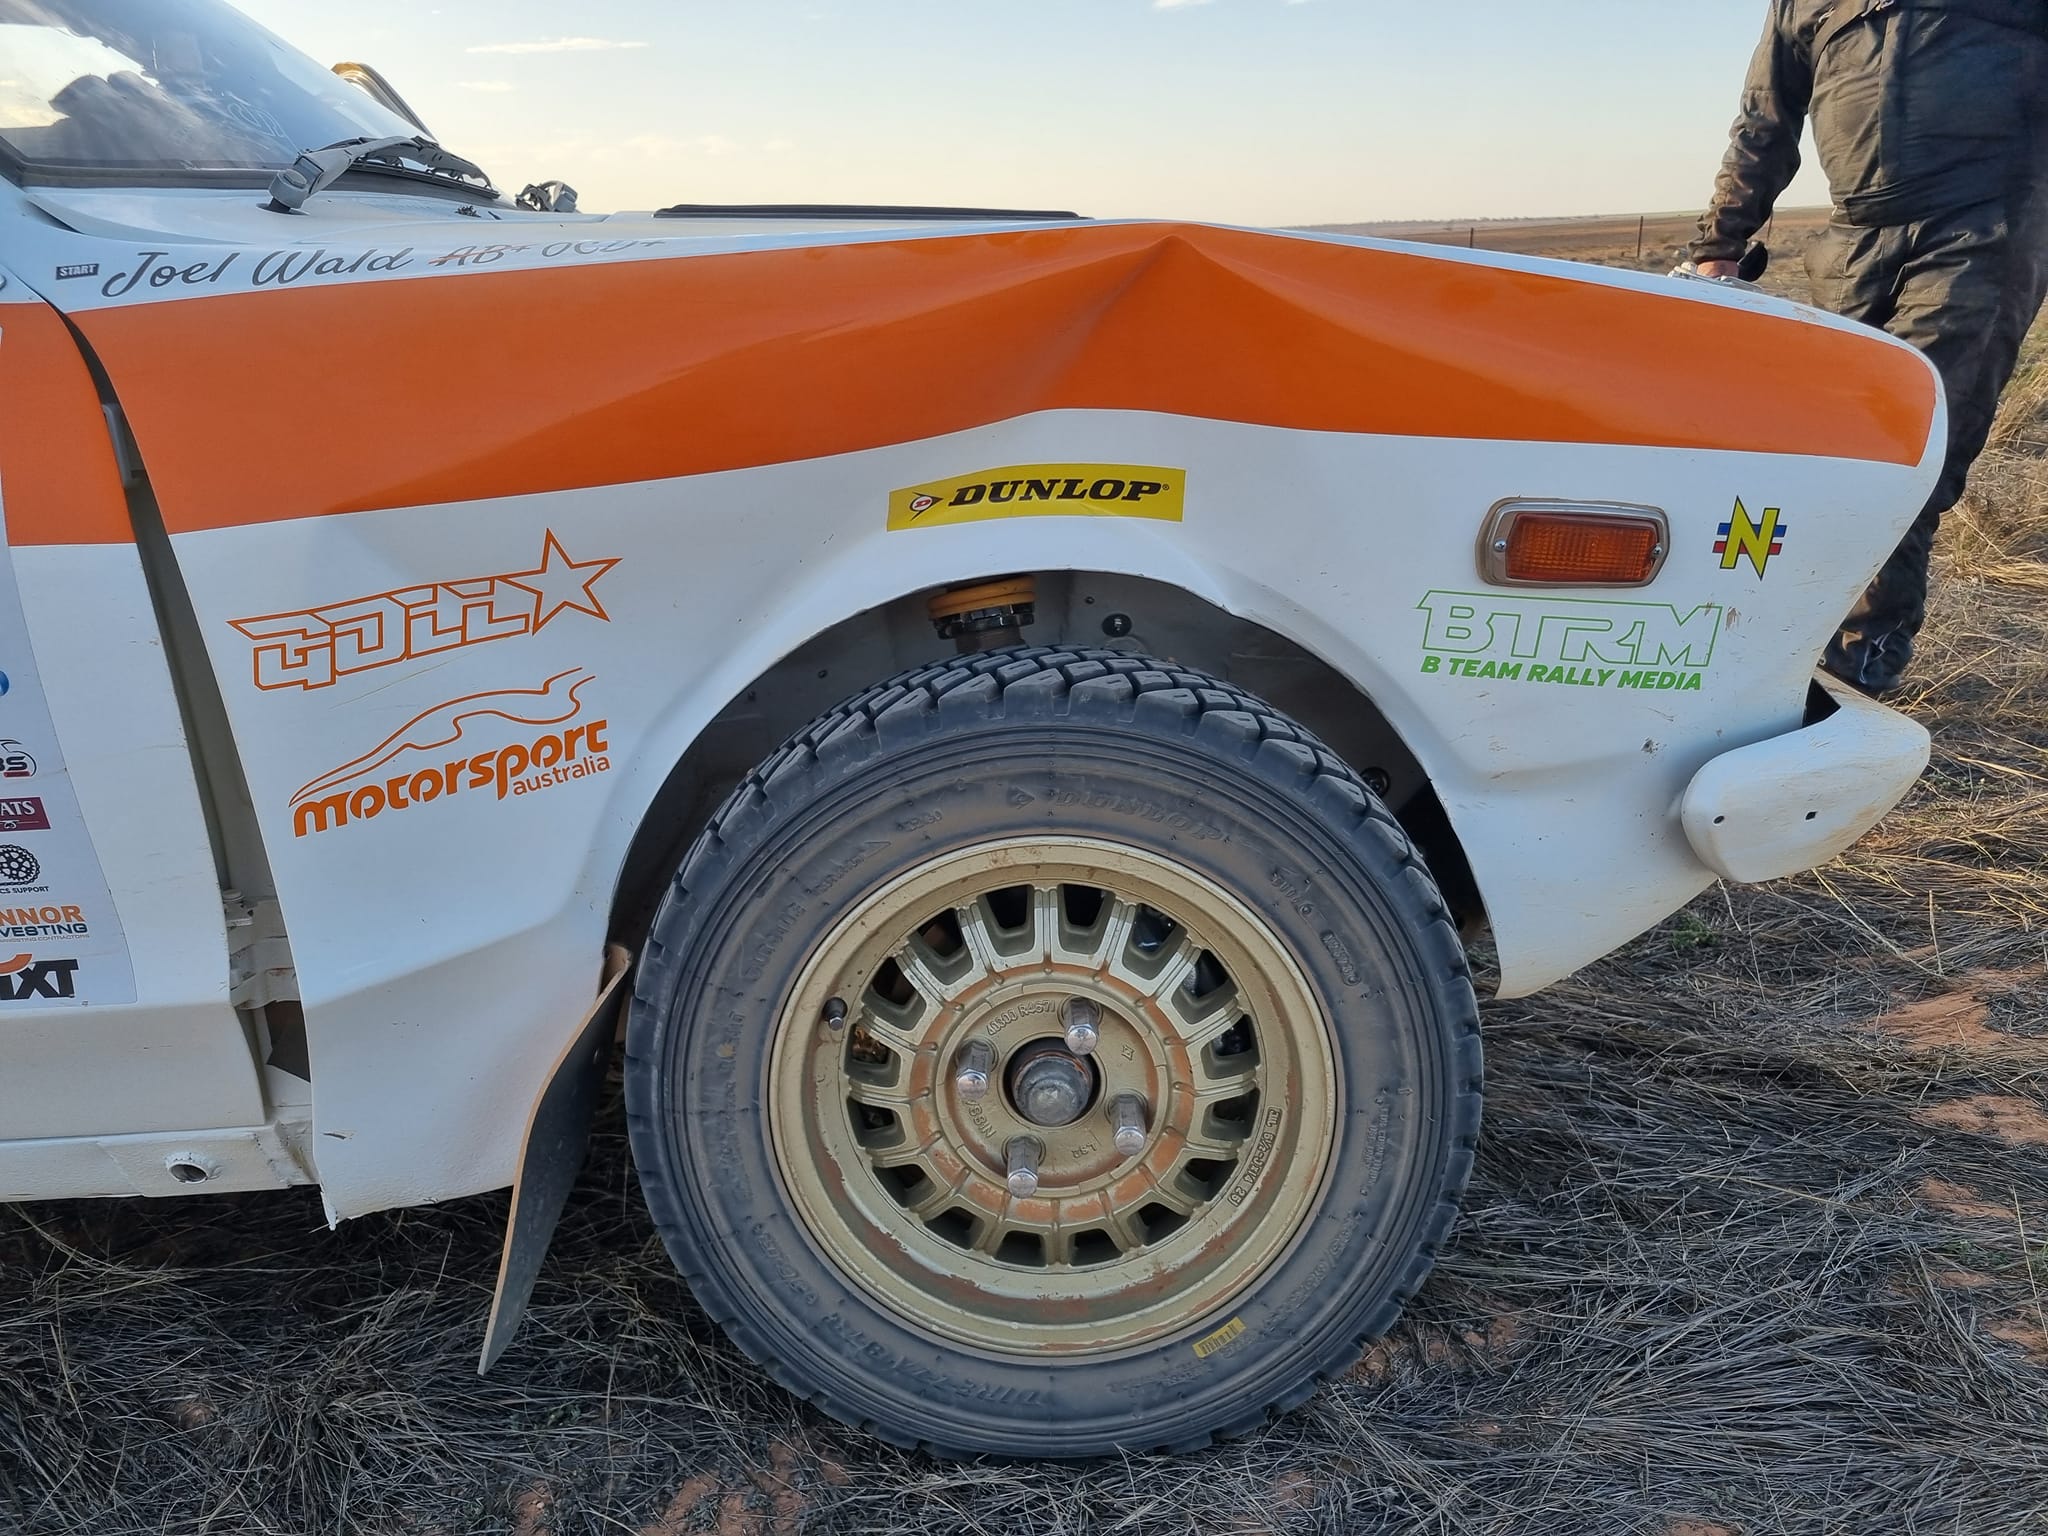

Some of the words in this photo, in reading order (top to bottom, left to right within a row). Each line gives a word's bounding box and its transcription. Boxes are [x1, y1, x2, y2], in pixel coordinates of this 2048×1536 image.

[59, 264, 97, 277] START
[102, 251, 240, 298] Joel
[252, 247, 414, 286] Wald
[1416, 589, 1724, 668] BTRM
[1420, 655, 1441, 674] B
[1448, 658, 1523, 681] TEAM
[1526, 664, 1616, 688] RALLY
[1616, 670, 1702, 691] MEDIA
[292, 719, 609, 838] motorsport
[512, 754, 611, 796] australia
[12, 886, 49, 894] SUPPORT
